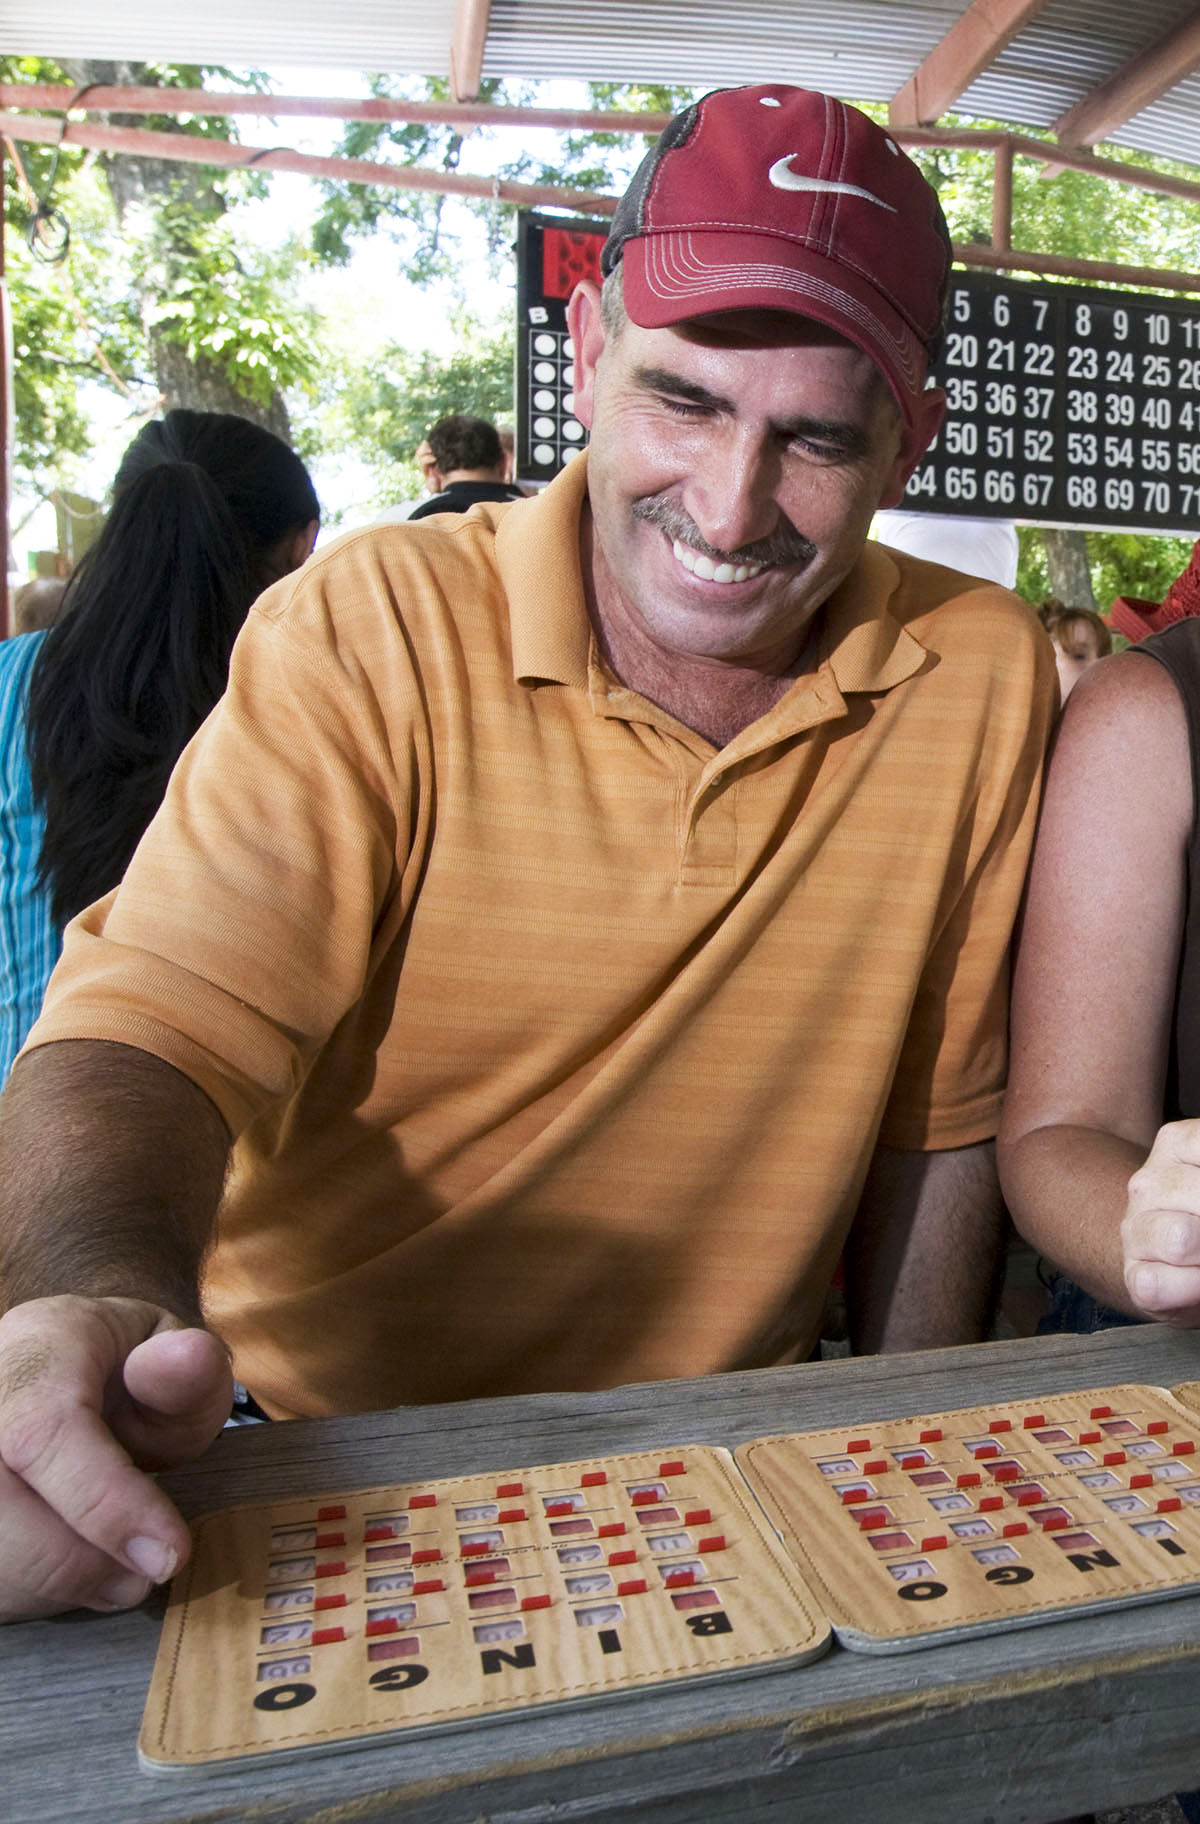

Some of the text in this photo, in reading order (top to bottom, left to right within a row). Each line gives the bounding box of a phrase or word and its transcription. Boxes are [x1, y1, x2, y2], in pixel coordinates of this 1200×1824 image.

[954, 289, 971, 323] 5
[993, 294, 1010, 327] 6
[1033, 299, 1049, 331] 7
[1075, 304, 1092, 337] 8
[1113, 309, 1129, 341] 9
[1144, 313, 1170, 346] 10
[945, 333, 978, 368] 20
[987, 337, 1015, 372] 21
[1023, 342, 1055, 377] 22
[1067, 345, 1099, 380] 23
[1104, 350, 1135, 384] 24
[1142, 354, 1172, 388] 25
[945, 377, 978, 412] 35
[984, 381, 1017, 417] 36
[1023, 386, 1055, 420] 37
[1066, 389, 1098, 424] 38
[1104, 393, 1135, 427] 39
[1141, 397, 1172, 430] 40
[945, 421, 978, 456] 50
[987, 425, 1014, 459] 51
[1023, 429, 1054, 463] 52
[1067, 432, 1098, 466] 53
[1104, 436, 1135, 469] 54
[1141, 439, 1172, 472] 55
[905, 465, 937, 497] 64
[944, 466, 978, 500] 65
[983, 469, 1016, 504] 66
[1023, 473, 1054, 506] 67
[1066, 475, 1098, 509] 68
[1104, 477, 1135, 511] 69
[1141, 481, 1171, 514] 70
[1066, 1549, 1121, 1572] N
[1157, 1538, 1187, 1556] I
[897, 1581, 948, 1601] O
[985, 1566, 1035, 1586] G
[253, 1611, 734, 1711] B I N G O
